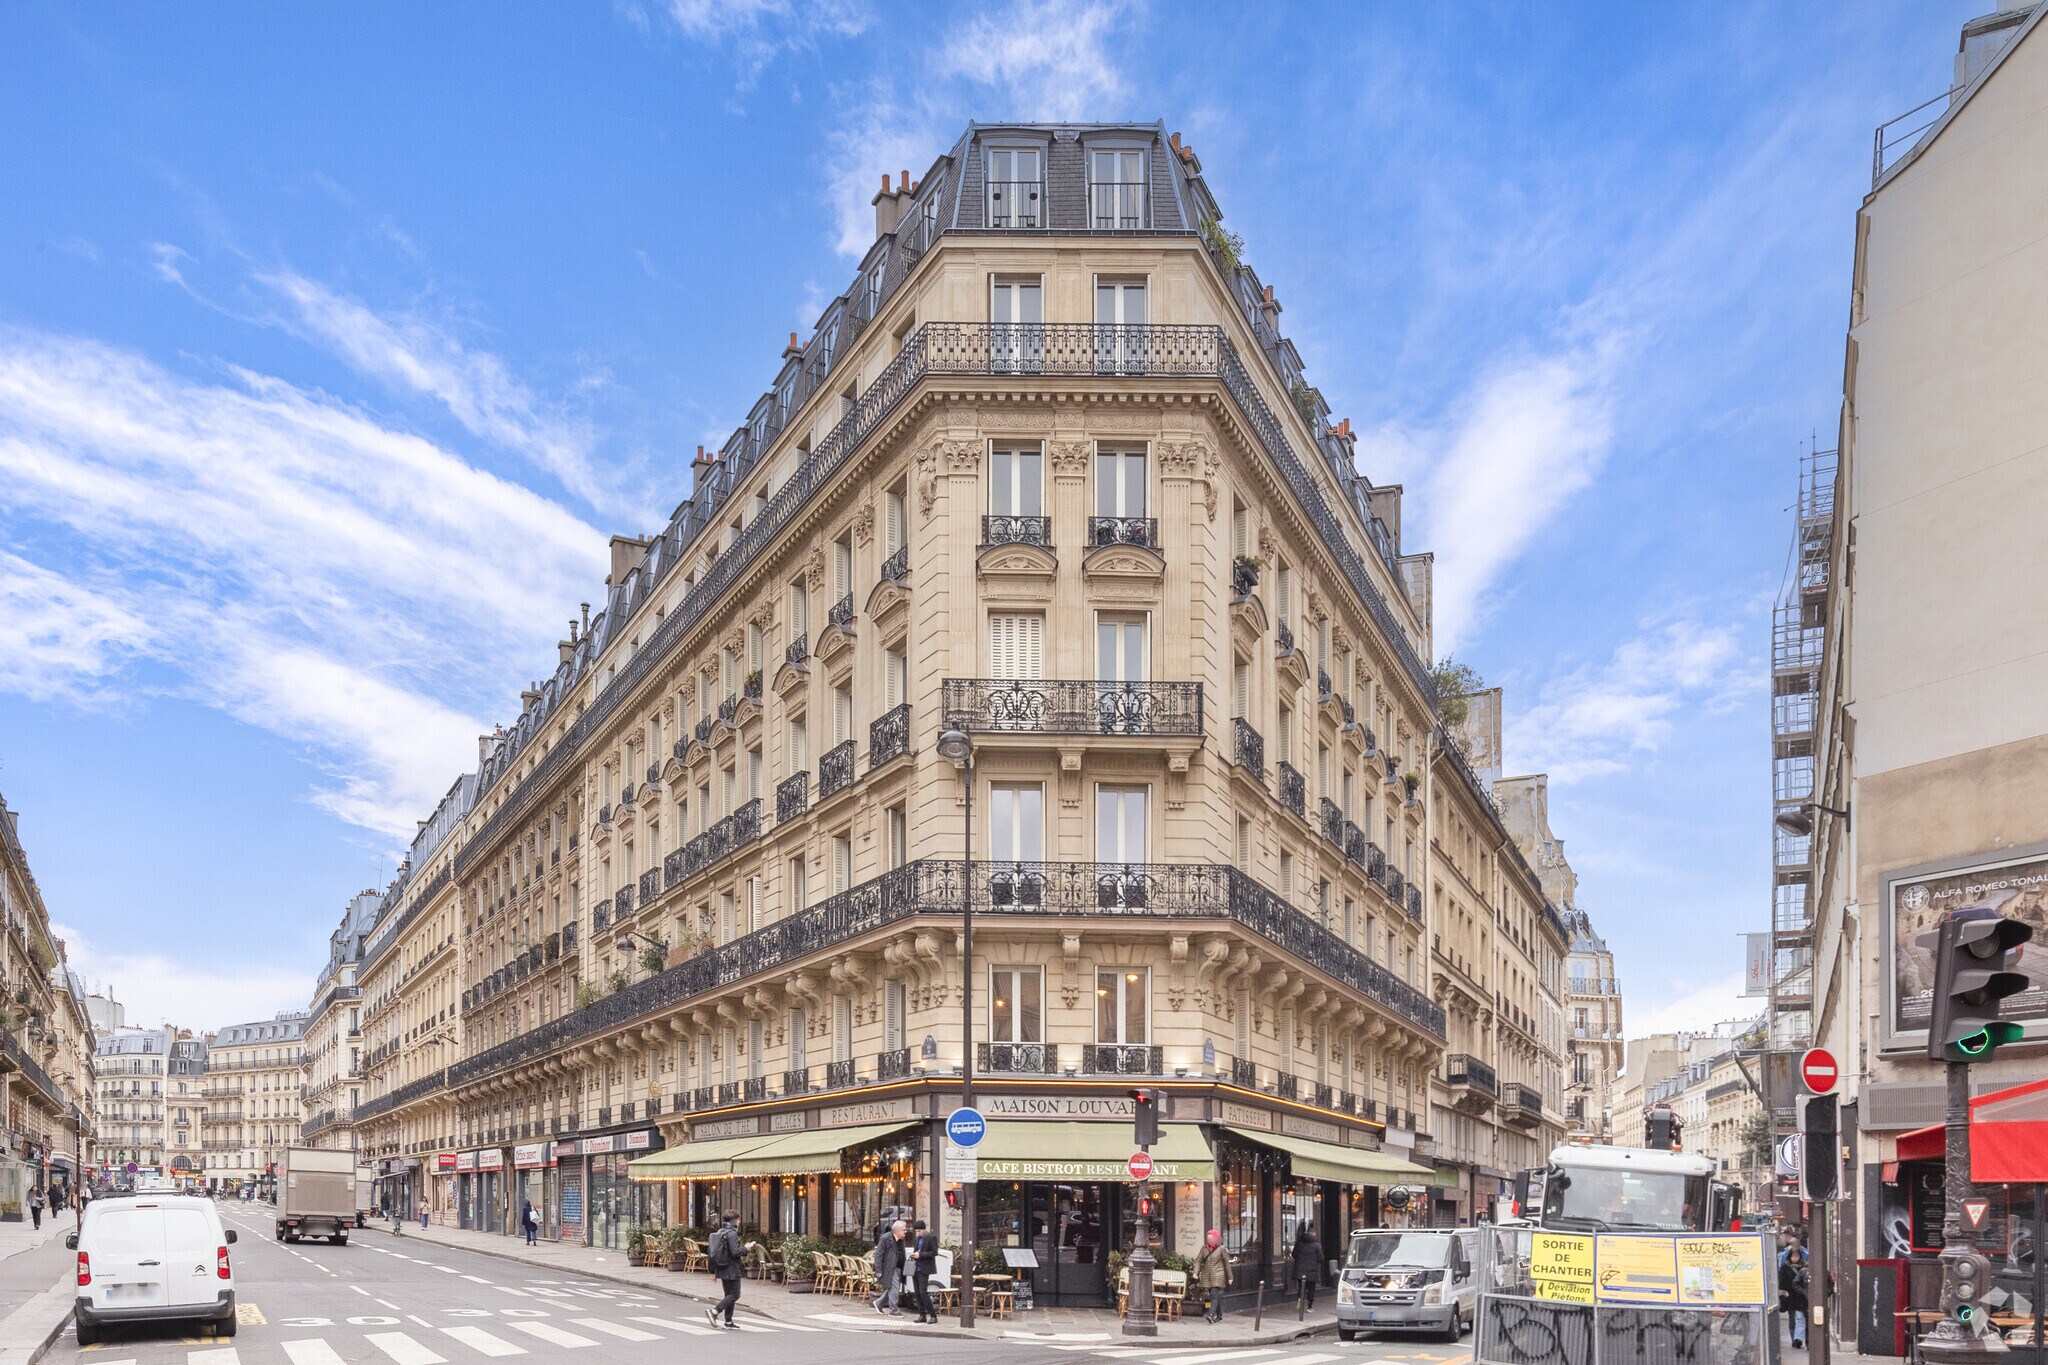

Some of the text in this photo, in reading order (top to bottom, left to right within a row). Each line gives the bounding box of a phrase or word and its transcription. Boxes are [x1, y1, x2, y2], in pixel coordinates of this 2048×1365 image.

[1933, 887, 1963, 900] ALFA
[1966, 881, 2008, 895] ROMEO
[832, 1102, 896, 1124] RESTAURANT
[990, 1099, 1060, 1114] MAISON
[775, 1113, 802, 1130] GLACES
[1228, 1106, 1267, 1127] PATISSERIE
[700, 1123, 721, 1137] SALON
[724, 1122, 733, 1135] DE
[983, 1162, 1179, 1176] CAFE BISTROT RESTAANT
[1542, 1239, 1585, 1251] SORTIE
[1555, 1253, 1570, 1263] DE
[1532, 1264, 1592, 1277] CHANTIER
[1547, 1281, 1591, 1295] Déviation
[440, 1309, 551, 1317] 30
[278, 1316, 401, 1327] 30
